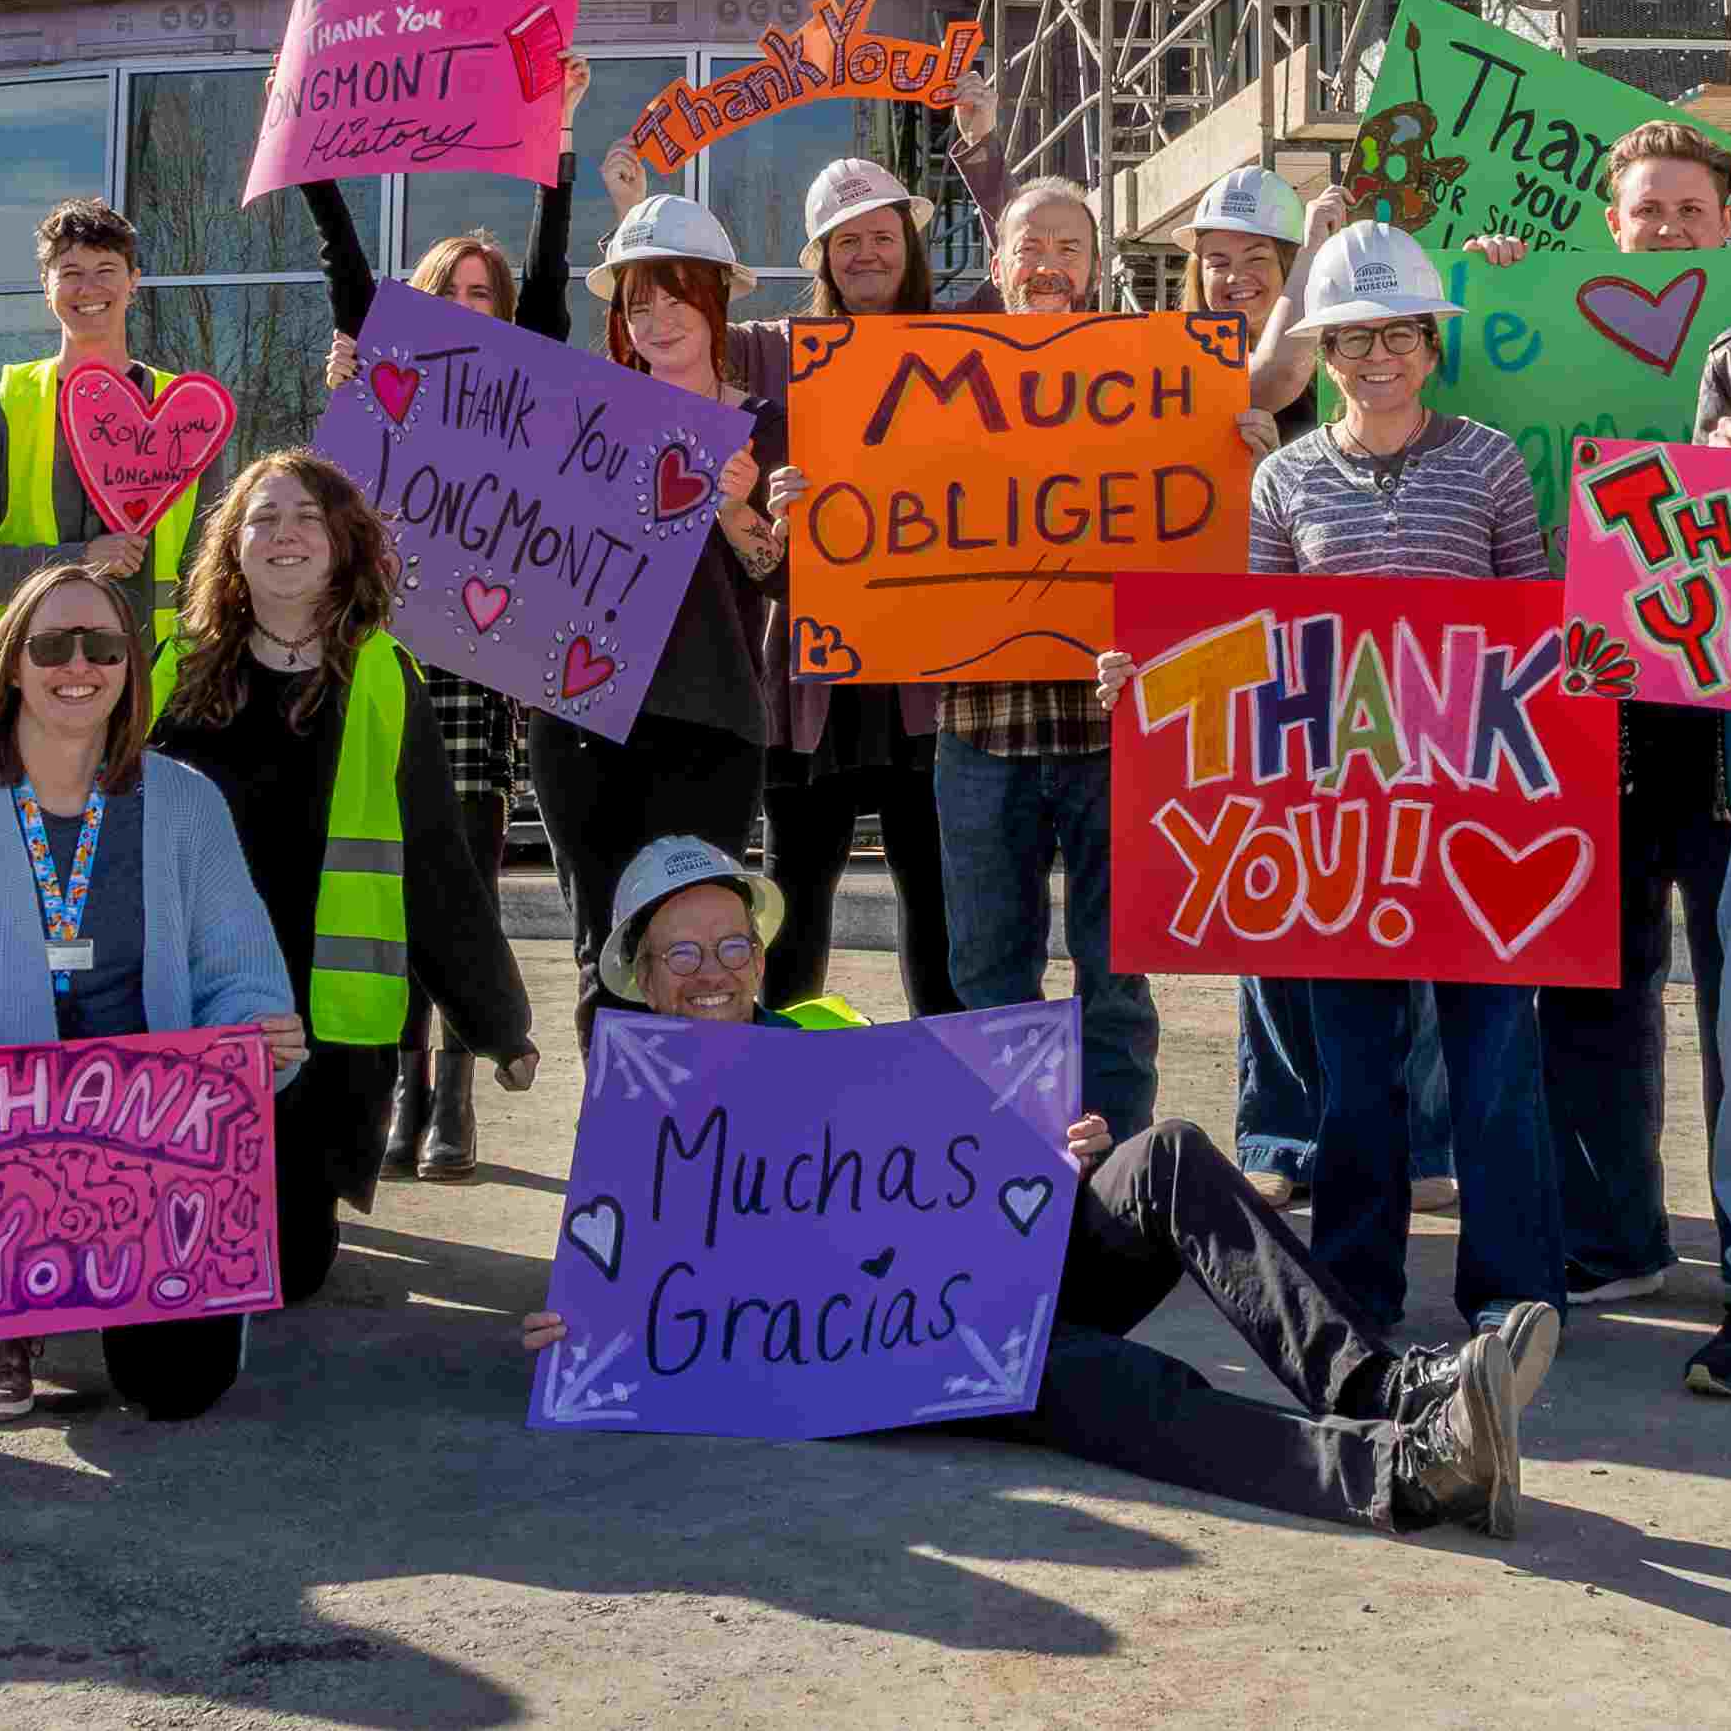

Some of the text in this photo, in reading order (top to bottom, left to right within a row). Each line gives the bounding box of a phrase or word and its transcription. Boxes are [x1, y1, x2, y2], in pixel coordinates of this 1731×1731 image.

[303, 10, 385, 58] THANK
[304, 118, 524, 167] History
[632, 28, 828, 166] Thank
[1448, 39, 1615, 204] Than
[1220, 204, 1256, 214] MUSEUM
[1511, 171, 1582, 231] YOU
[1353, 280, 1398, 293] MUSEUM
[413, 345, 536, 453] THANK
[862, 348, 1193, 446] MUCH
[372, 427, 650, 623] LONGMONT!
[808, 464, 1215, 566] OBLIGED
[1133, 608, 1563, 801] THANK
[1150, 794, 1436, 948] YOU!
[651, 1104, 981, 1248] Muchas
[645, 1247, 977, 1377] Gracias
